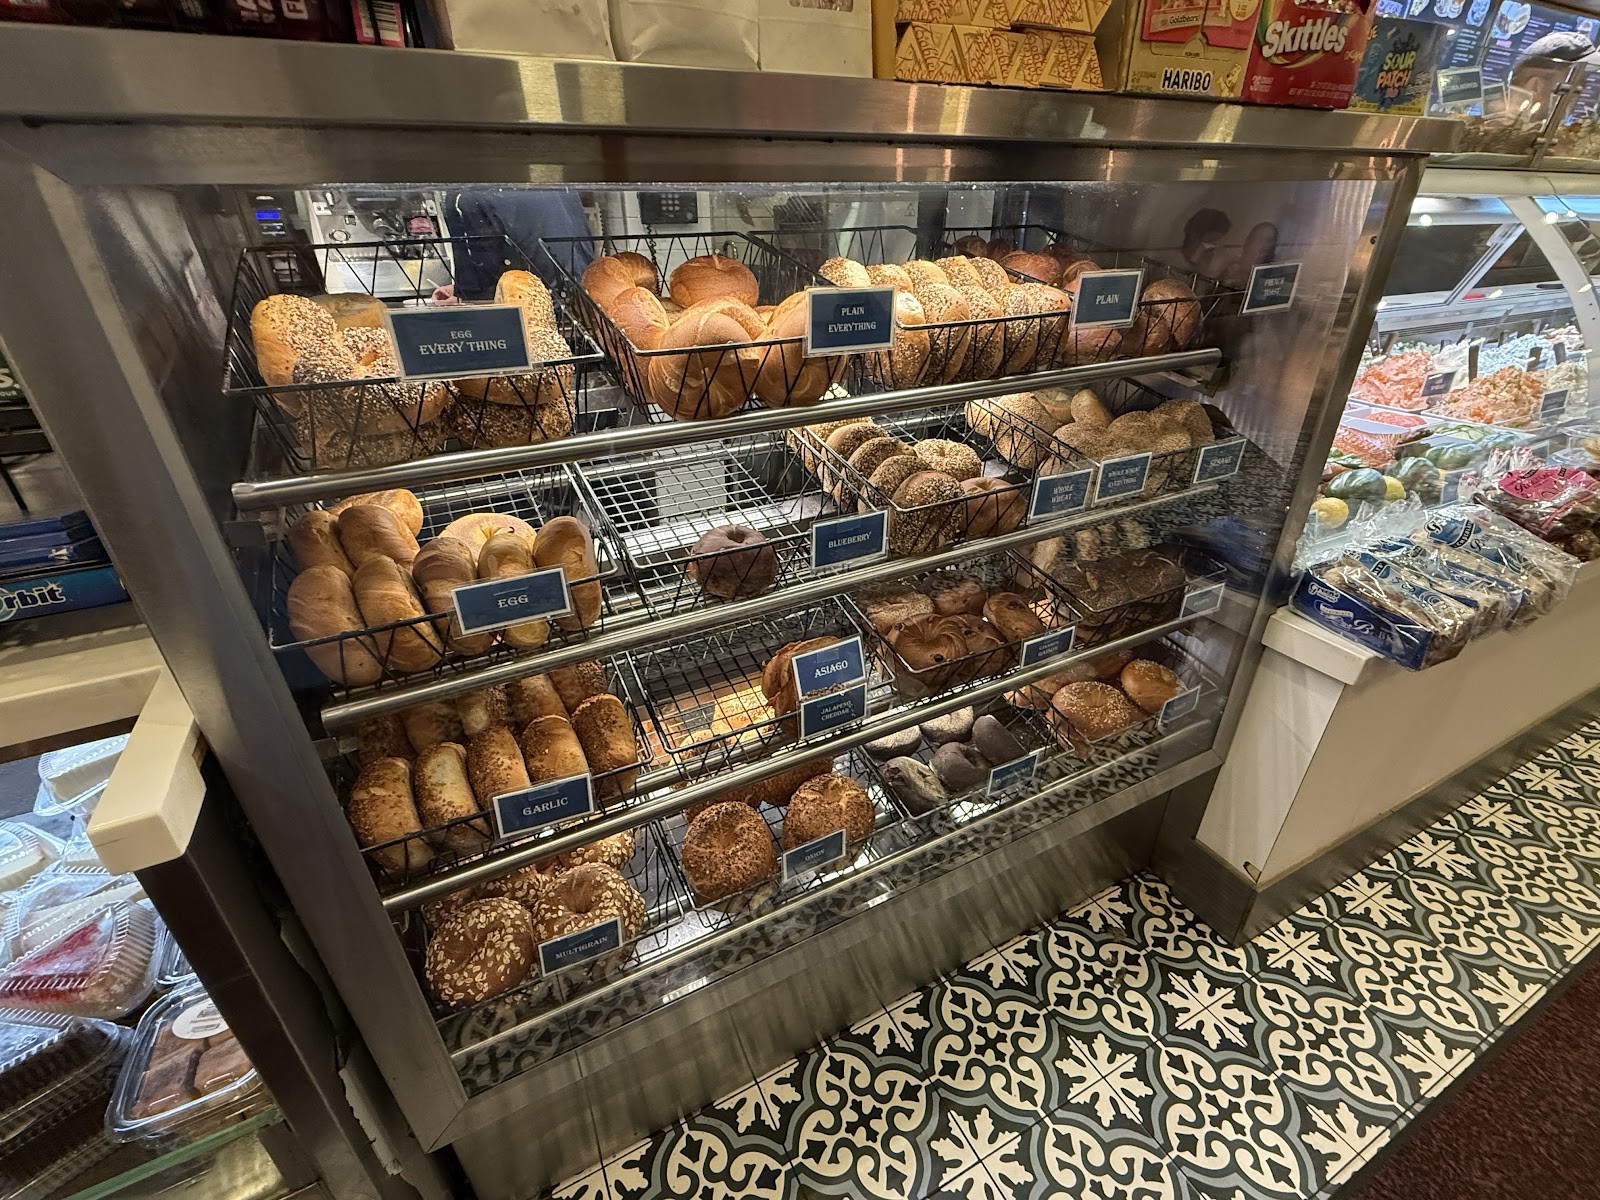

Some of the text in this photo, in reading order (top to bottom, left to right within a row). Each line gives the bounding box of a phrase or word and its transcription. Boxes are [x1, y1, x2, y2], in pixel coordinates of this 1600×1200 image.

[1262, 17, 1348, 57] Skittles
[1383, 51, 1416, 70] SOUR
[1161, 69, 1211, 91] HARIBO
[1376, 69, 1412, 89] PATCH
[1096, 294, 1120, 305] PLAIN
[841, 307, 865, 316] PLAIN
[450, 330, 472, 339] EGG
[828, 322, 877, 333] EVERYTHING
[419, 339, 507, 355] EVERY THING
[1053, 484, 1075, 494] WHOLE
[1051, 493, 1073, 503] WHEAT
[828, 531, 872, 549] BLUEBERRY
[497, 594, 529, 609] EGG
[814, 660, 848, 678] ASIAGO
[821, 708, 850, 720] CHEDDAR
[522, 797, 569, 816] GARLIC
[804, 849, 825, 860] ONION
[555, 936, 608, 960] MULTIGRAIN
